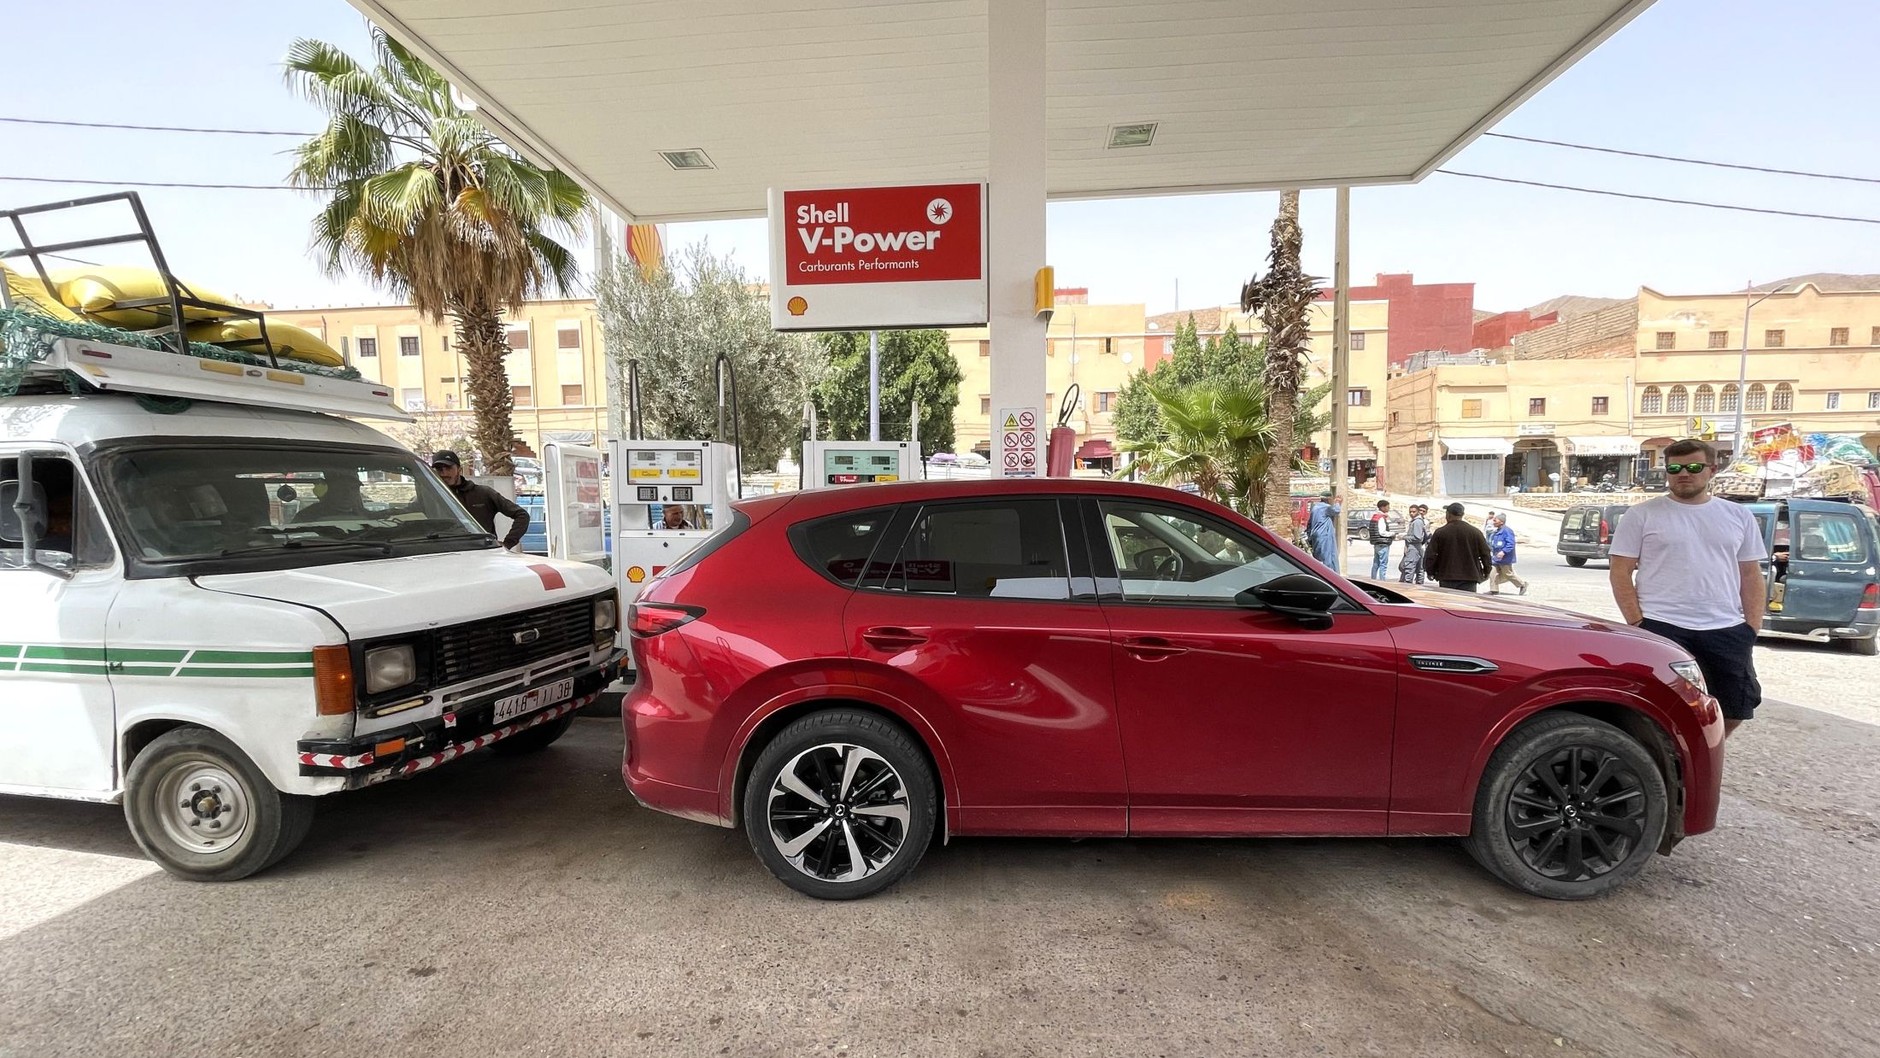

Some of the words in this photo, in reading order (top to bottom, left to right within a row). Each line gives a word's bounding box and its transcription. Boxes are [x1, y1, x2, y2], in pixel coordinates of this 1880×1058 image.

[797, 202, 849, 225] Shell
[798, 226, 941, 254] V-Power
[799, 259, 855, 272] Carburants
[858, 258, 920, 270] Performants
[499, 696, 527, 718] 4418
[557, 682, 570, 700] 38
